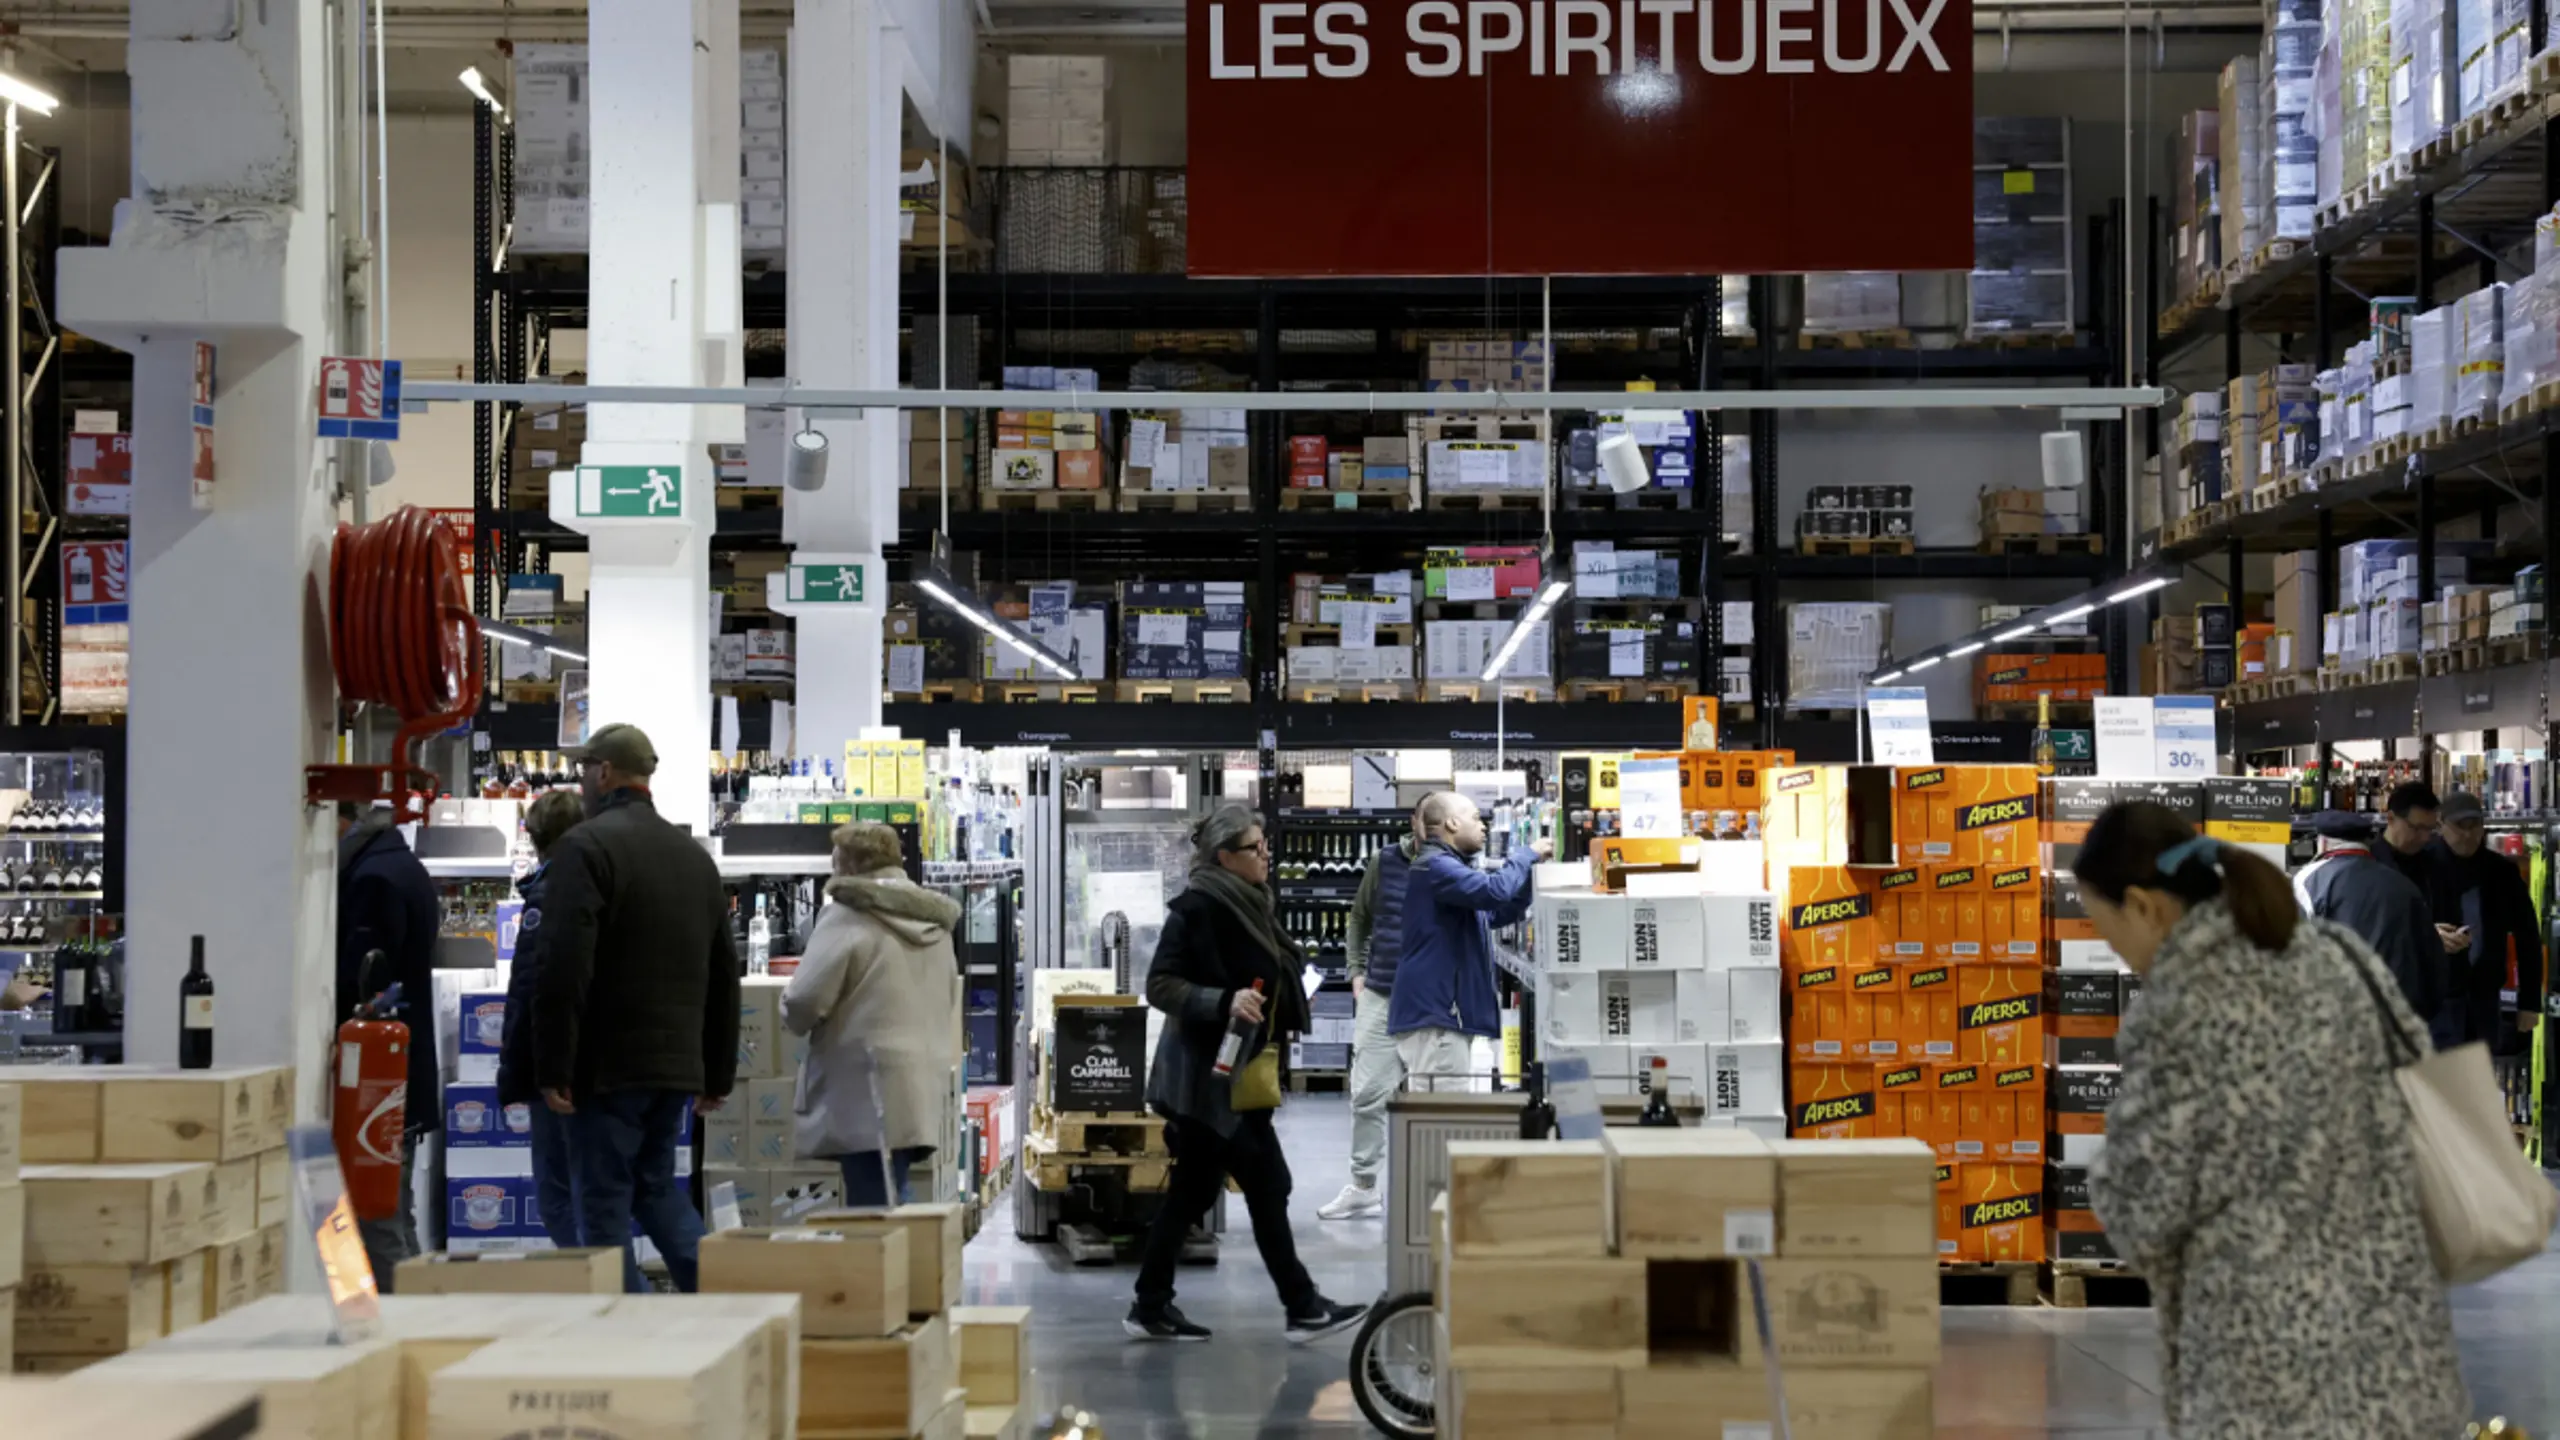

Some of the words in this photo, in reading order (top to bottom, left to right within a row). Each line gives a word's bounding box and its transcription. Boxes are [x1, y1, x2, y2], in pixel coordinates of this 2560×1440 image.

[1209, 2, 1370, 79] LES
[1405, 0, 1951, 77] SPIRITUEUX
[1966, 799, 2028, 827] APEROL
[2214, 793, 2283, 806] PERLINO
[1749, 902, 1759, 941] HEART
[1760, 902, 1771, 941] LION
[1799, 899, 1859, 926] APEROL
[1558, 924, 1570, 963] LION
[1570, 924, 1580, 963] HEART
[1635, 923, 1647, 962] LION
[1647, 922, 1658, 962] HEART
[1970, 999, 2030, 1027] APEROL
[2064, 990, 2113, 1000] PERLINO
[1608, 997, 1620, 1035] LION
[1620, 996, 1630, 1035] HEART
[1070, 1064, 1132, 1078] CAMPBELL
[1085, 1055, 1119, 1067] CLAN
[1717, 1070, 1730, 1109] LION
[1730, 1069, 1740, 1109] HEART
[2068, 1085, 2122, 1098] PERLIN
[1804, 1097, 1863, 1124] APEROL
[1973, 1199, 2031, 1226] APEROL
